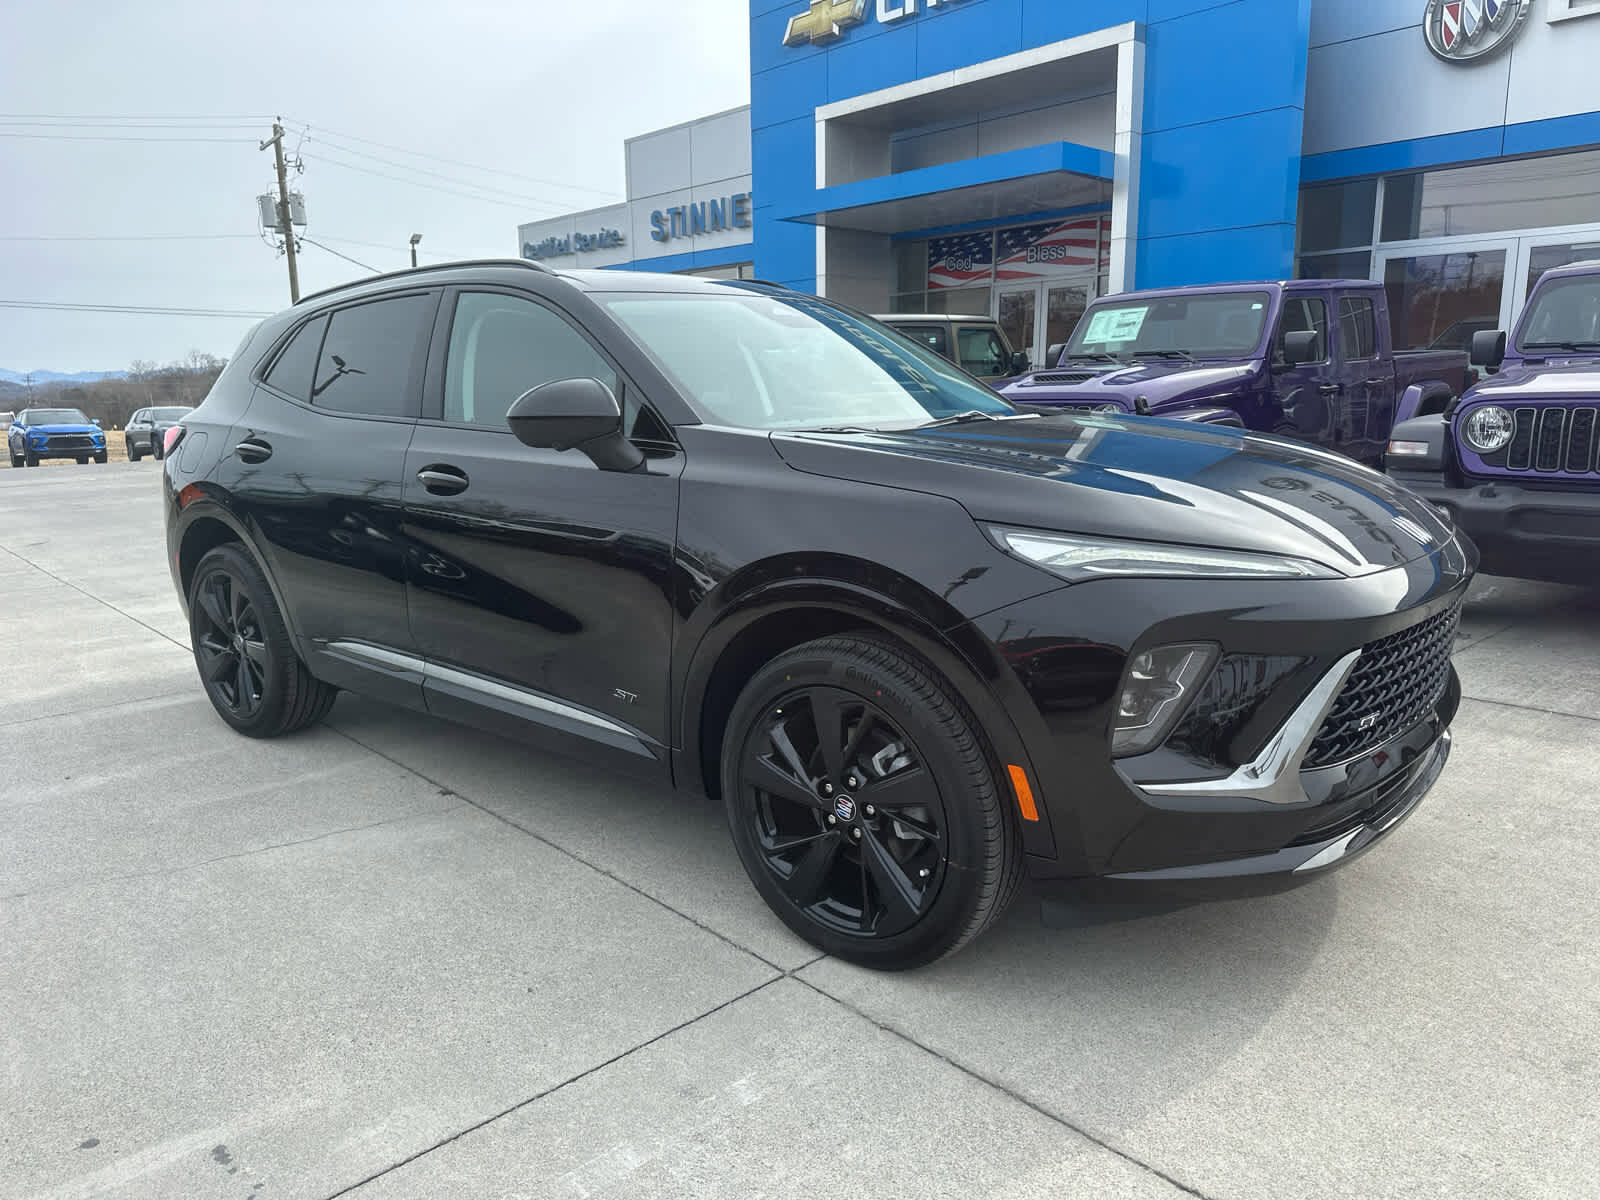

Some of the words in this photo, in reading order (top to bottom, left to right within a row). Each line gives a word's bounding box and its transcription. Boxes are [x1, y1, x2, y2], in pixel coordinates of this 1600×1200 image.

[650, 191, 752, 242] STINNE
[573, 227, 623, 252] Service
[945, 255, 974, 271] God
[1026, 245, 1066, 263] Bless
